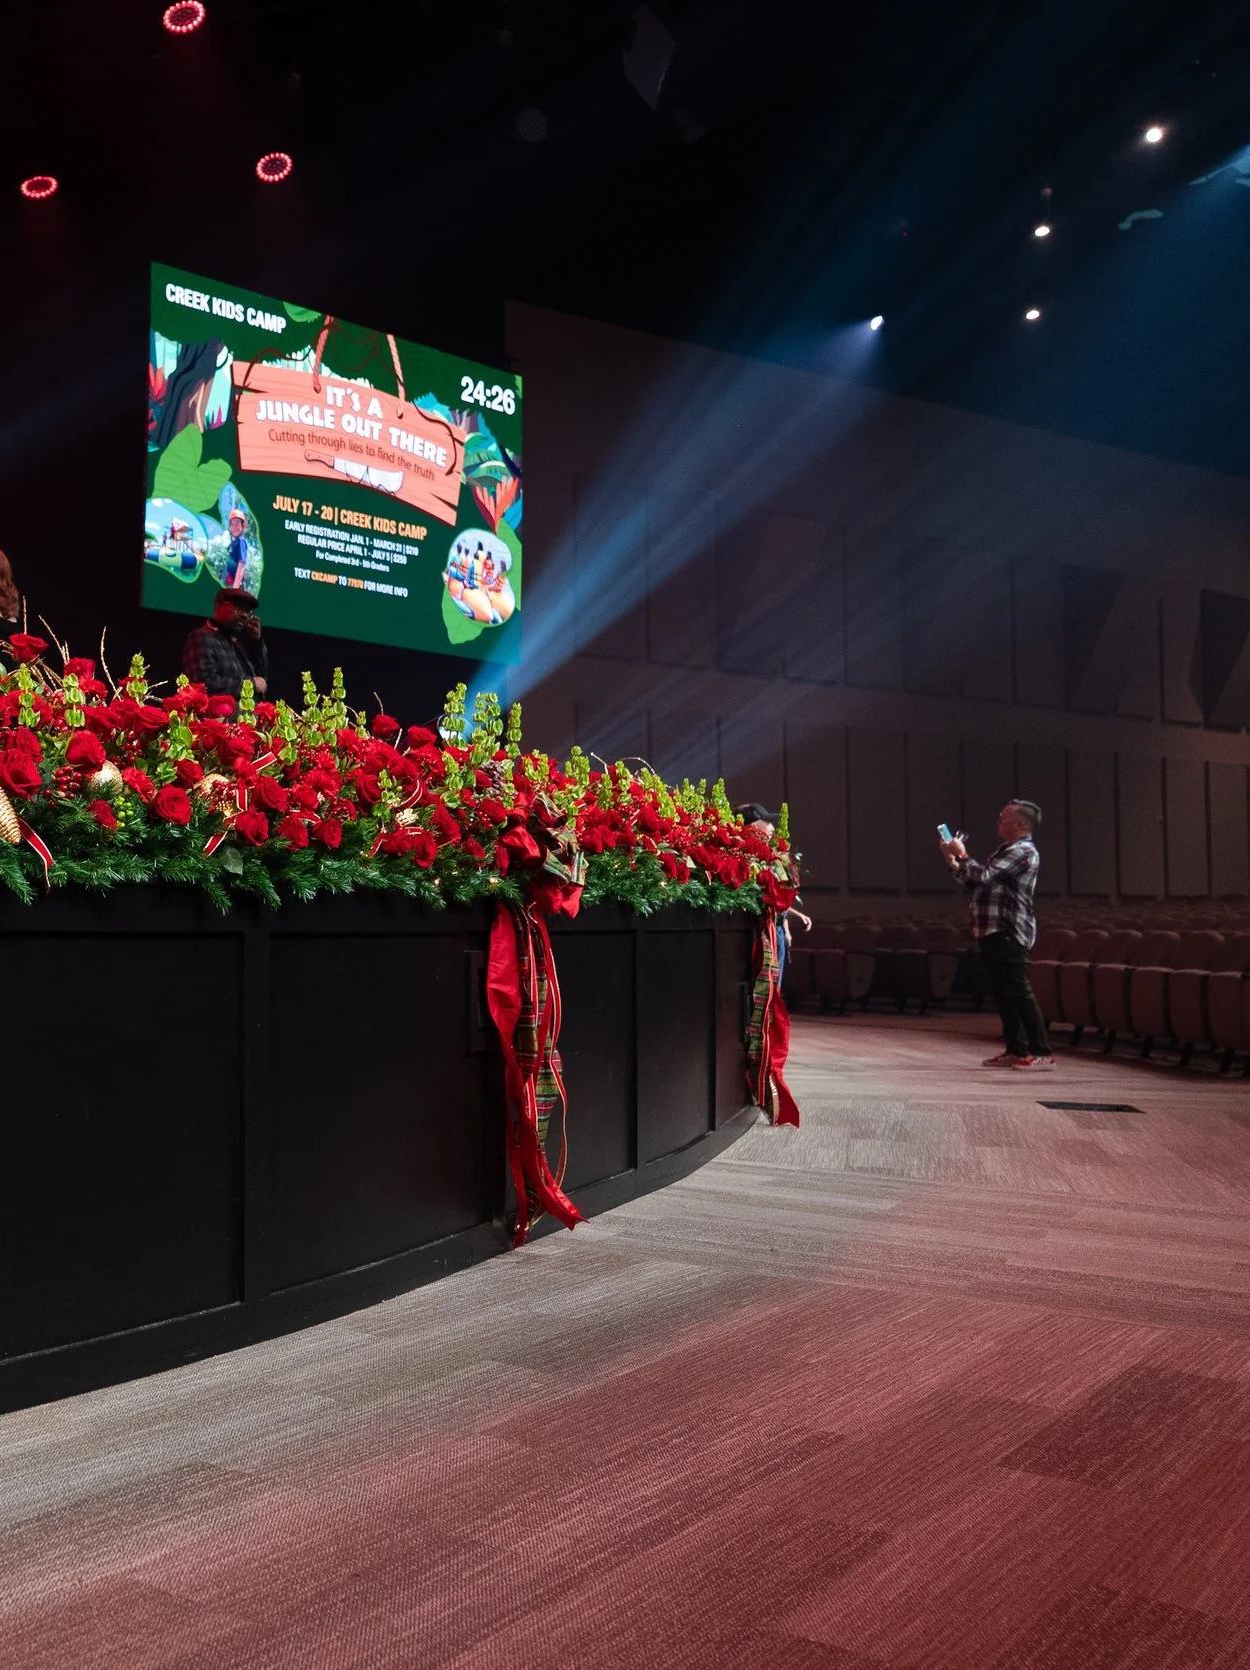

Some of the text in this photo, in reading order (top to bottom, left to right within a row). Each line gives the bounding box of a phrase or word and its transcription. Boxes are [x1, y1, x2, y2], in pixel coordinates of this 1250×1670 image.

[166, 283, 287, 334] CREEK KIDS CAMP
[326, 385, 383, 419] IT'S A
[461, 376, 515, 415] 24:26
[256, 400, 447, 467] JUNGLE OUT THERE
[268, 429, 435, 481] Cutting through lies to find the truth
[273, 495, 300, 514] JULY
[301, 502, 313, 517] 17
[320, 506, 333, 521] 20
[340, 510, 372, 529] CREEK
[373, 517, 397, 535] KIDS
[398, 522, 428, 540] CAMP
[285, 520, 305, 533] EARLY
[306, 524, 350, 542] REGISTRATION
[373, 538, 395, 551] MARCH
[297, 534, 327, 549] REGULAR
[327, 541, 345, 553] PRICE
[345, 544, 363, 556] APRIL
[371, 550, 386, 560] JULY
[315, 551, 324, 560] For
[294, 568, 310, 580] TEXT
[338, 576, 347, 586] TO
[364, 581, 376, 592] FOR
[376, 583, 393, 595] MORE
[394, 587, 408, 598] INFO
